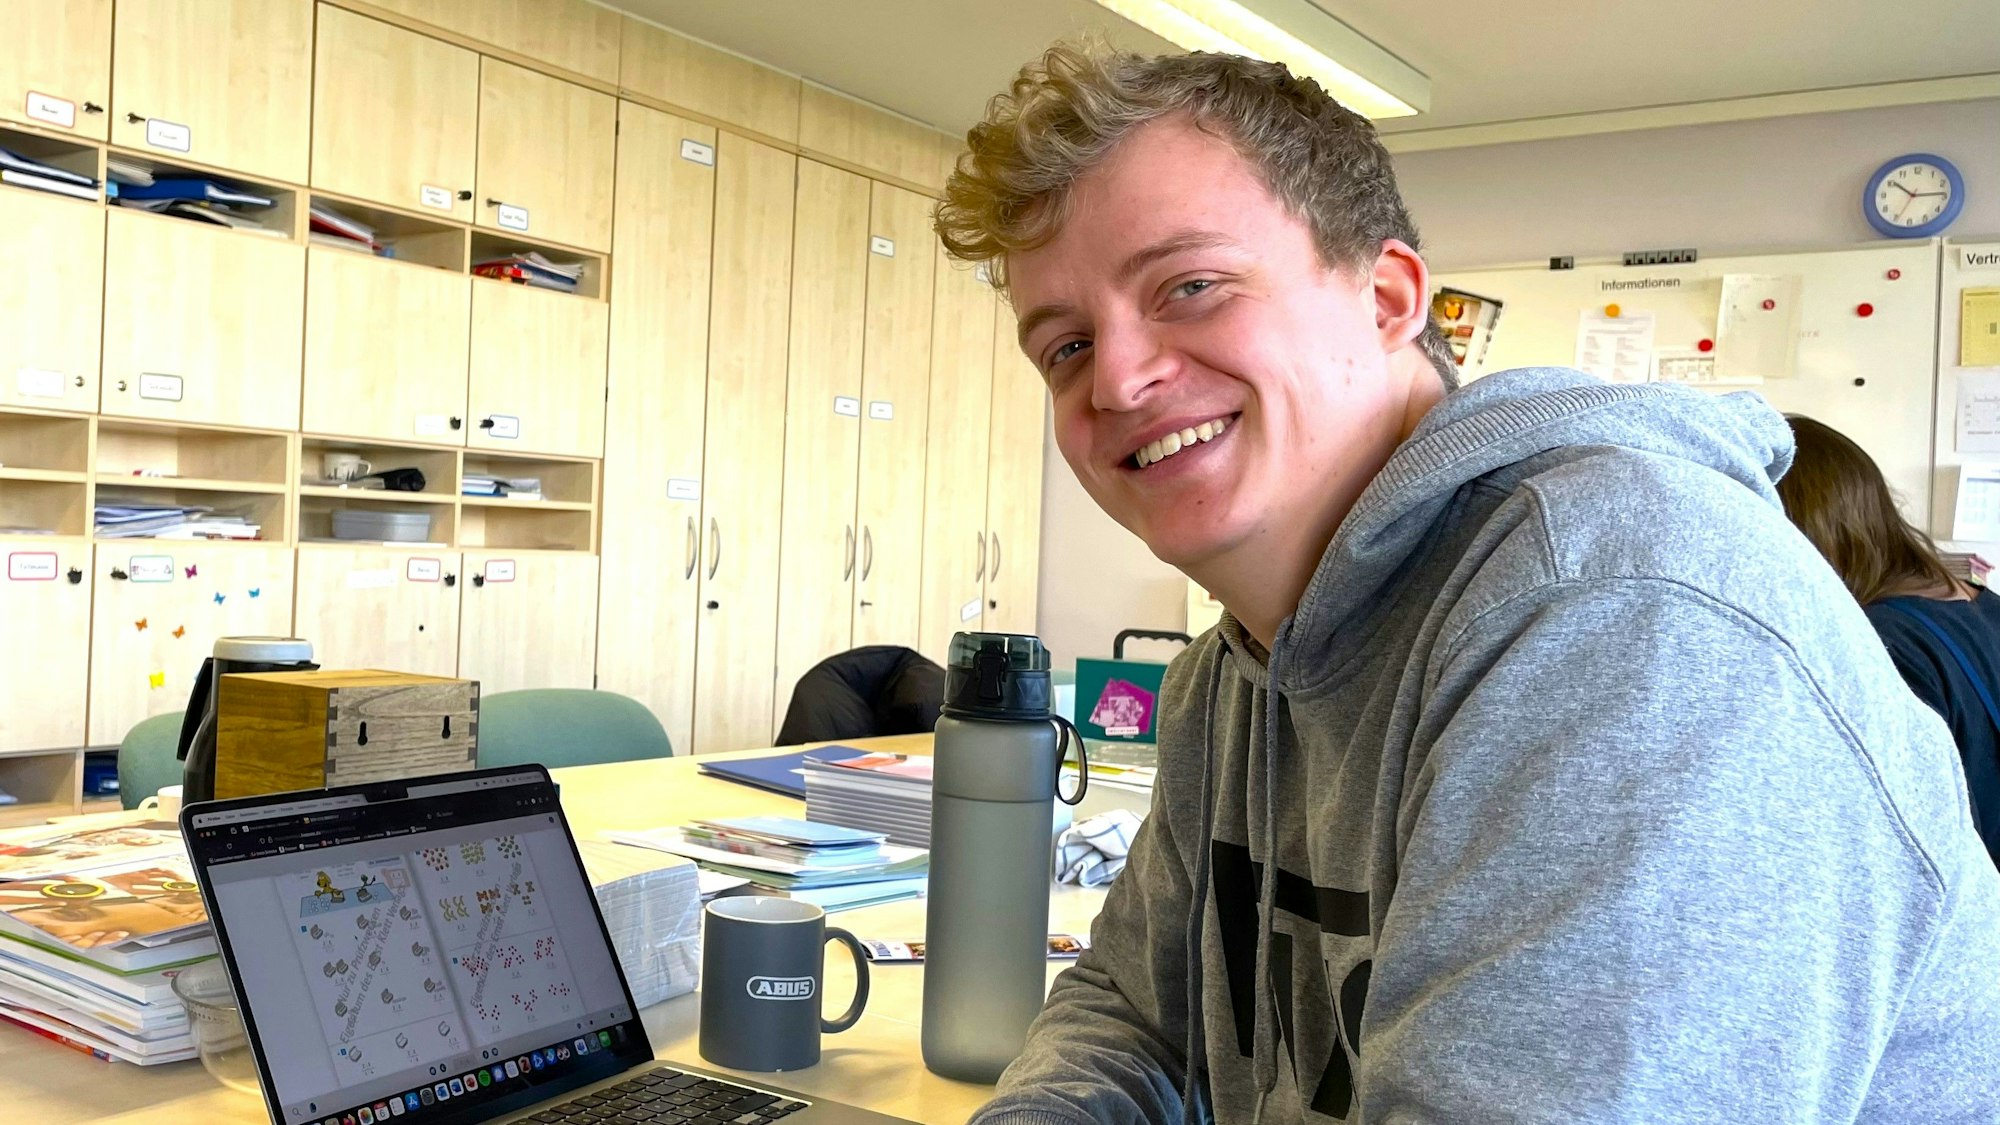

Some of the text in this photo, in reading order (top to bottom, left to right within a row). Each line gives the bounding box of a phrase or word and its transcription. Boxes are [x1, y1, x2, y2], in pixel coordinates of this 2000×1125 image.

[1967, 252, 2000, 265] Vertr
[1601, 278, 1681, 291] Informationen
[368, 944, 382, 971] Est
[755, 980, 810, 996] ABUS
